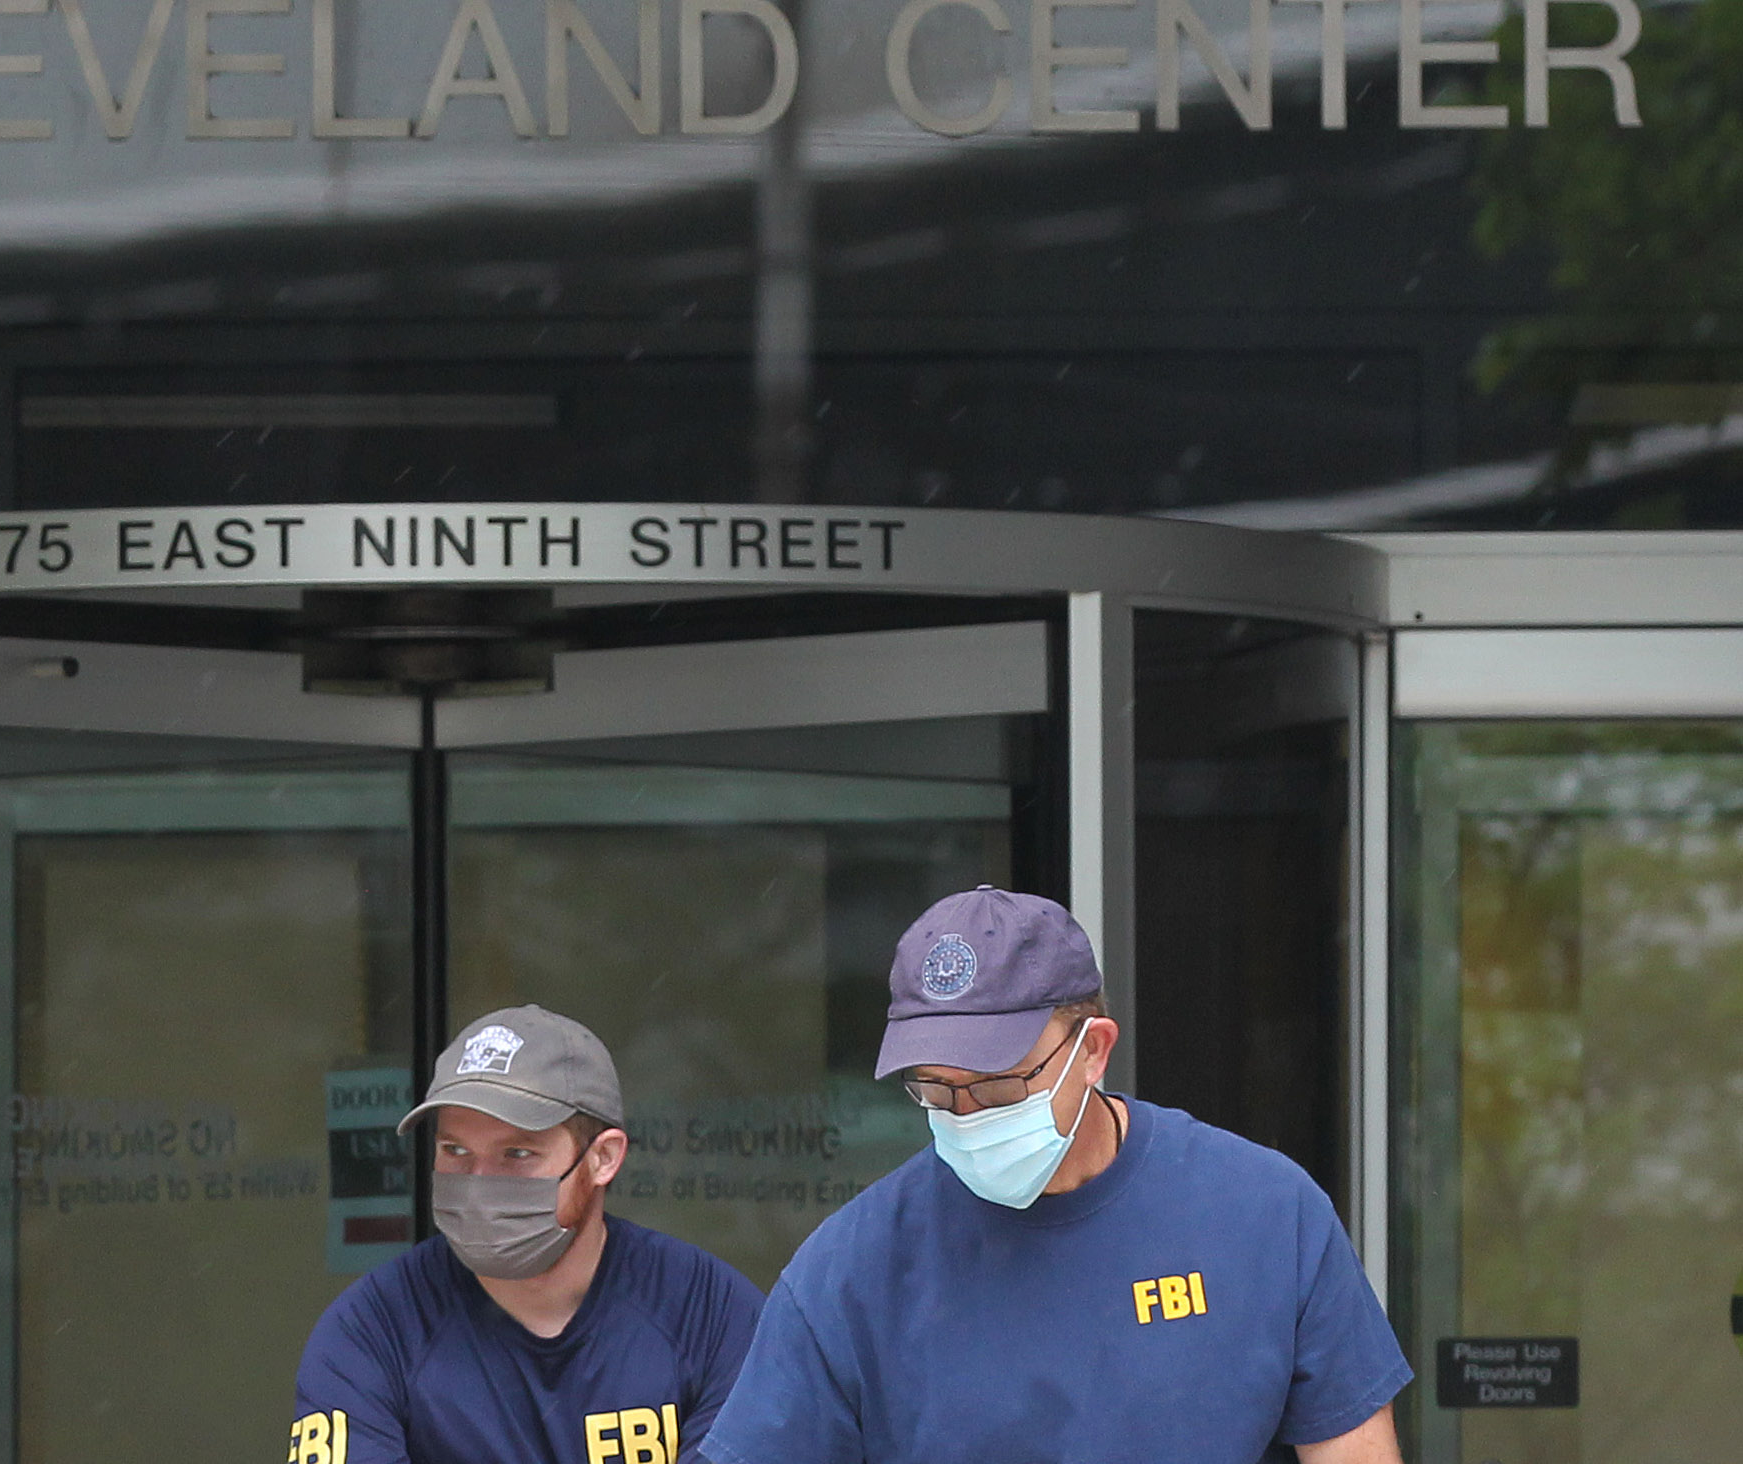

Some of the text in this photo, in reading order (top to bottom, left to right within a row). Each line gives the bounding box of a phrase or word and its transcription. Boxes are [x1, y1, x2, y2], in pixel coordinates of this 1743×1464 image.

[885, 0, 1643, 137] CENTER
[117, 514, 306, 572] EAST
[353, 513, 582, 569] NINTH
[628, 515, 907, 570] STREET
[1132, 1270, 1208, 1326] FBI
[1453, 1342, 1562, 1362] Please Use
[1462, 1363, 1553, 1386] Revolving
[1478, 1384, 1537, 1402] Doors
